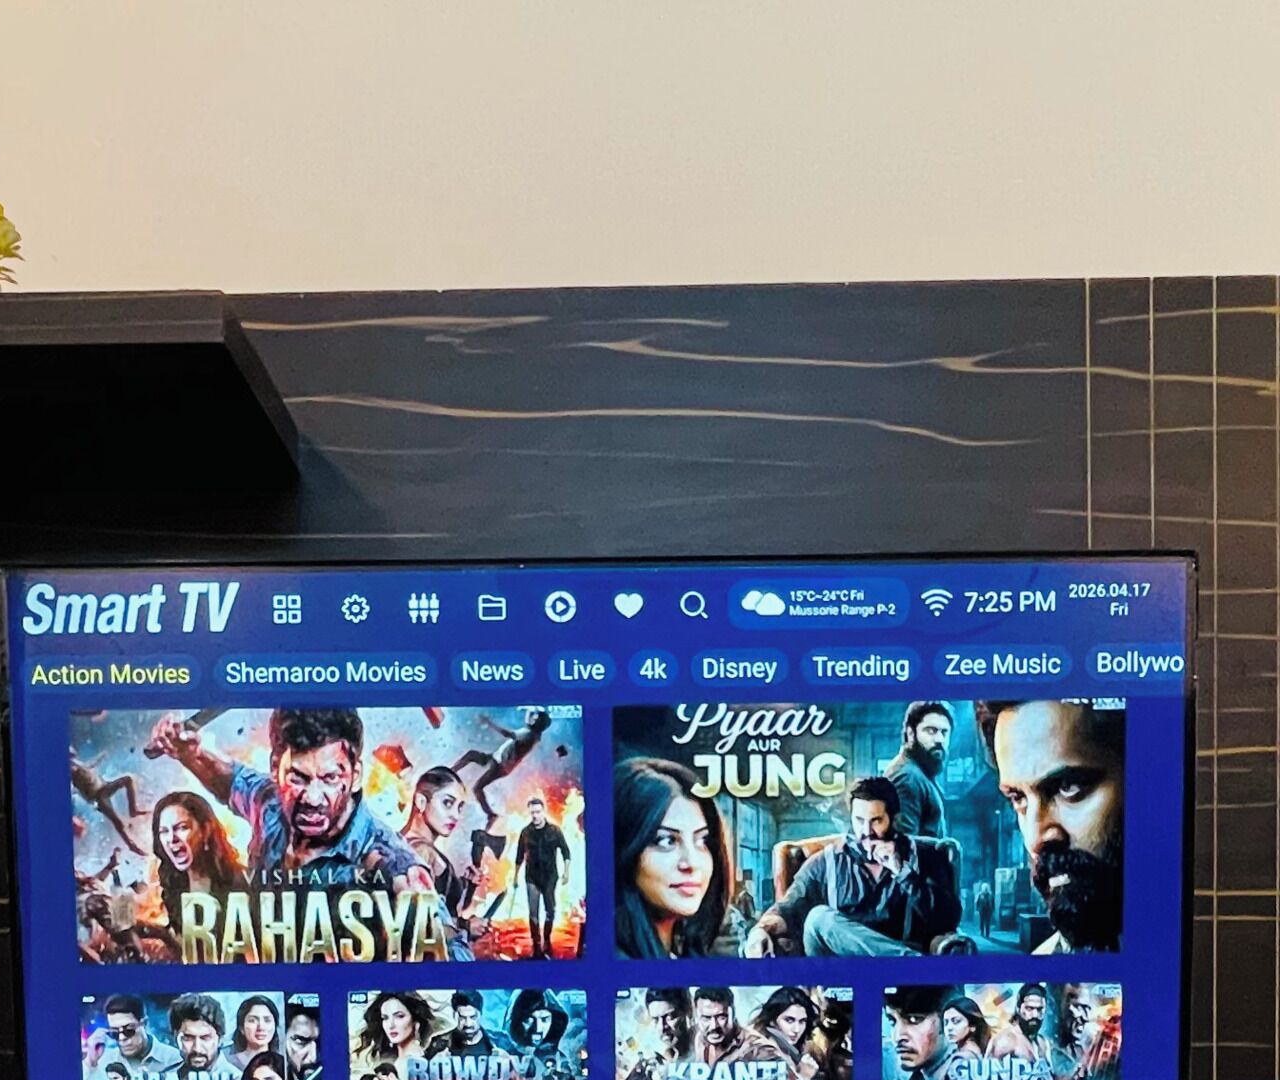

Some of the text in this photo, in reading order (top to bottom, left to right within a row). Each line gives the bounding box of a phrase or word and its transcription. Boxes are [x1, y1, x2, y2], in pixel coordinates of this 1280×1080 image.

[849, 589, 865, 601] Fri
[964, 590, 1057, 613] 7:25 PM
[1068, 583, 1151, 598] 2026.04.17
[22, 581, 241, 636] Smart TV
[841, 604, 876, 618] Range
[876, 603, 897, 615] P-2
[1109, 602, 1129, 616] Fri
[30, 662, 191, 685] Action Movies
[225, 660, 427, 684] Shemaroo Movies
[461, 659, 524, 681] News
[558, 659, 606, 681] Live
[638, 658, 668, 680] 4k
[701, 657, 778, 684] Disney
[811, 655, 911, 682] Trending
[944, 652, 1062, 676] Zee Music
[1096, 651, 1186, 676] Bollywo
[672, 703, 834, 753] Pyaar
[747, 740, 782, 753] AUR
[690, 752, 847, 800] JUNG
[241, 868, 387, 885] VISHAL KA
[180, 891, 449, 963] RAHASYA
